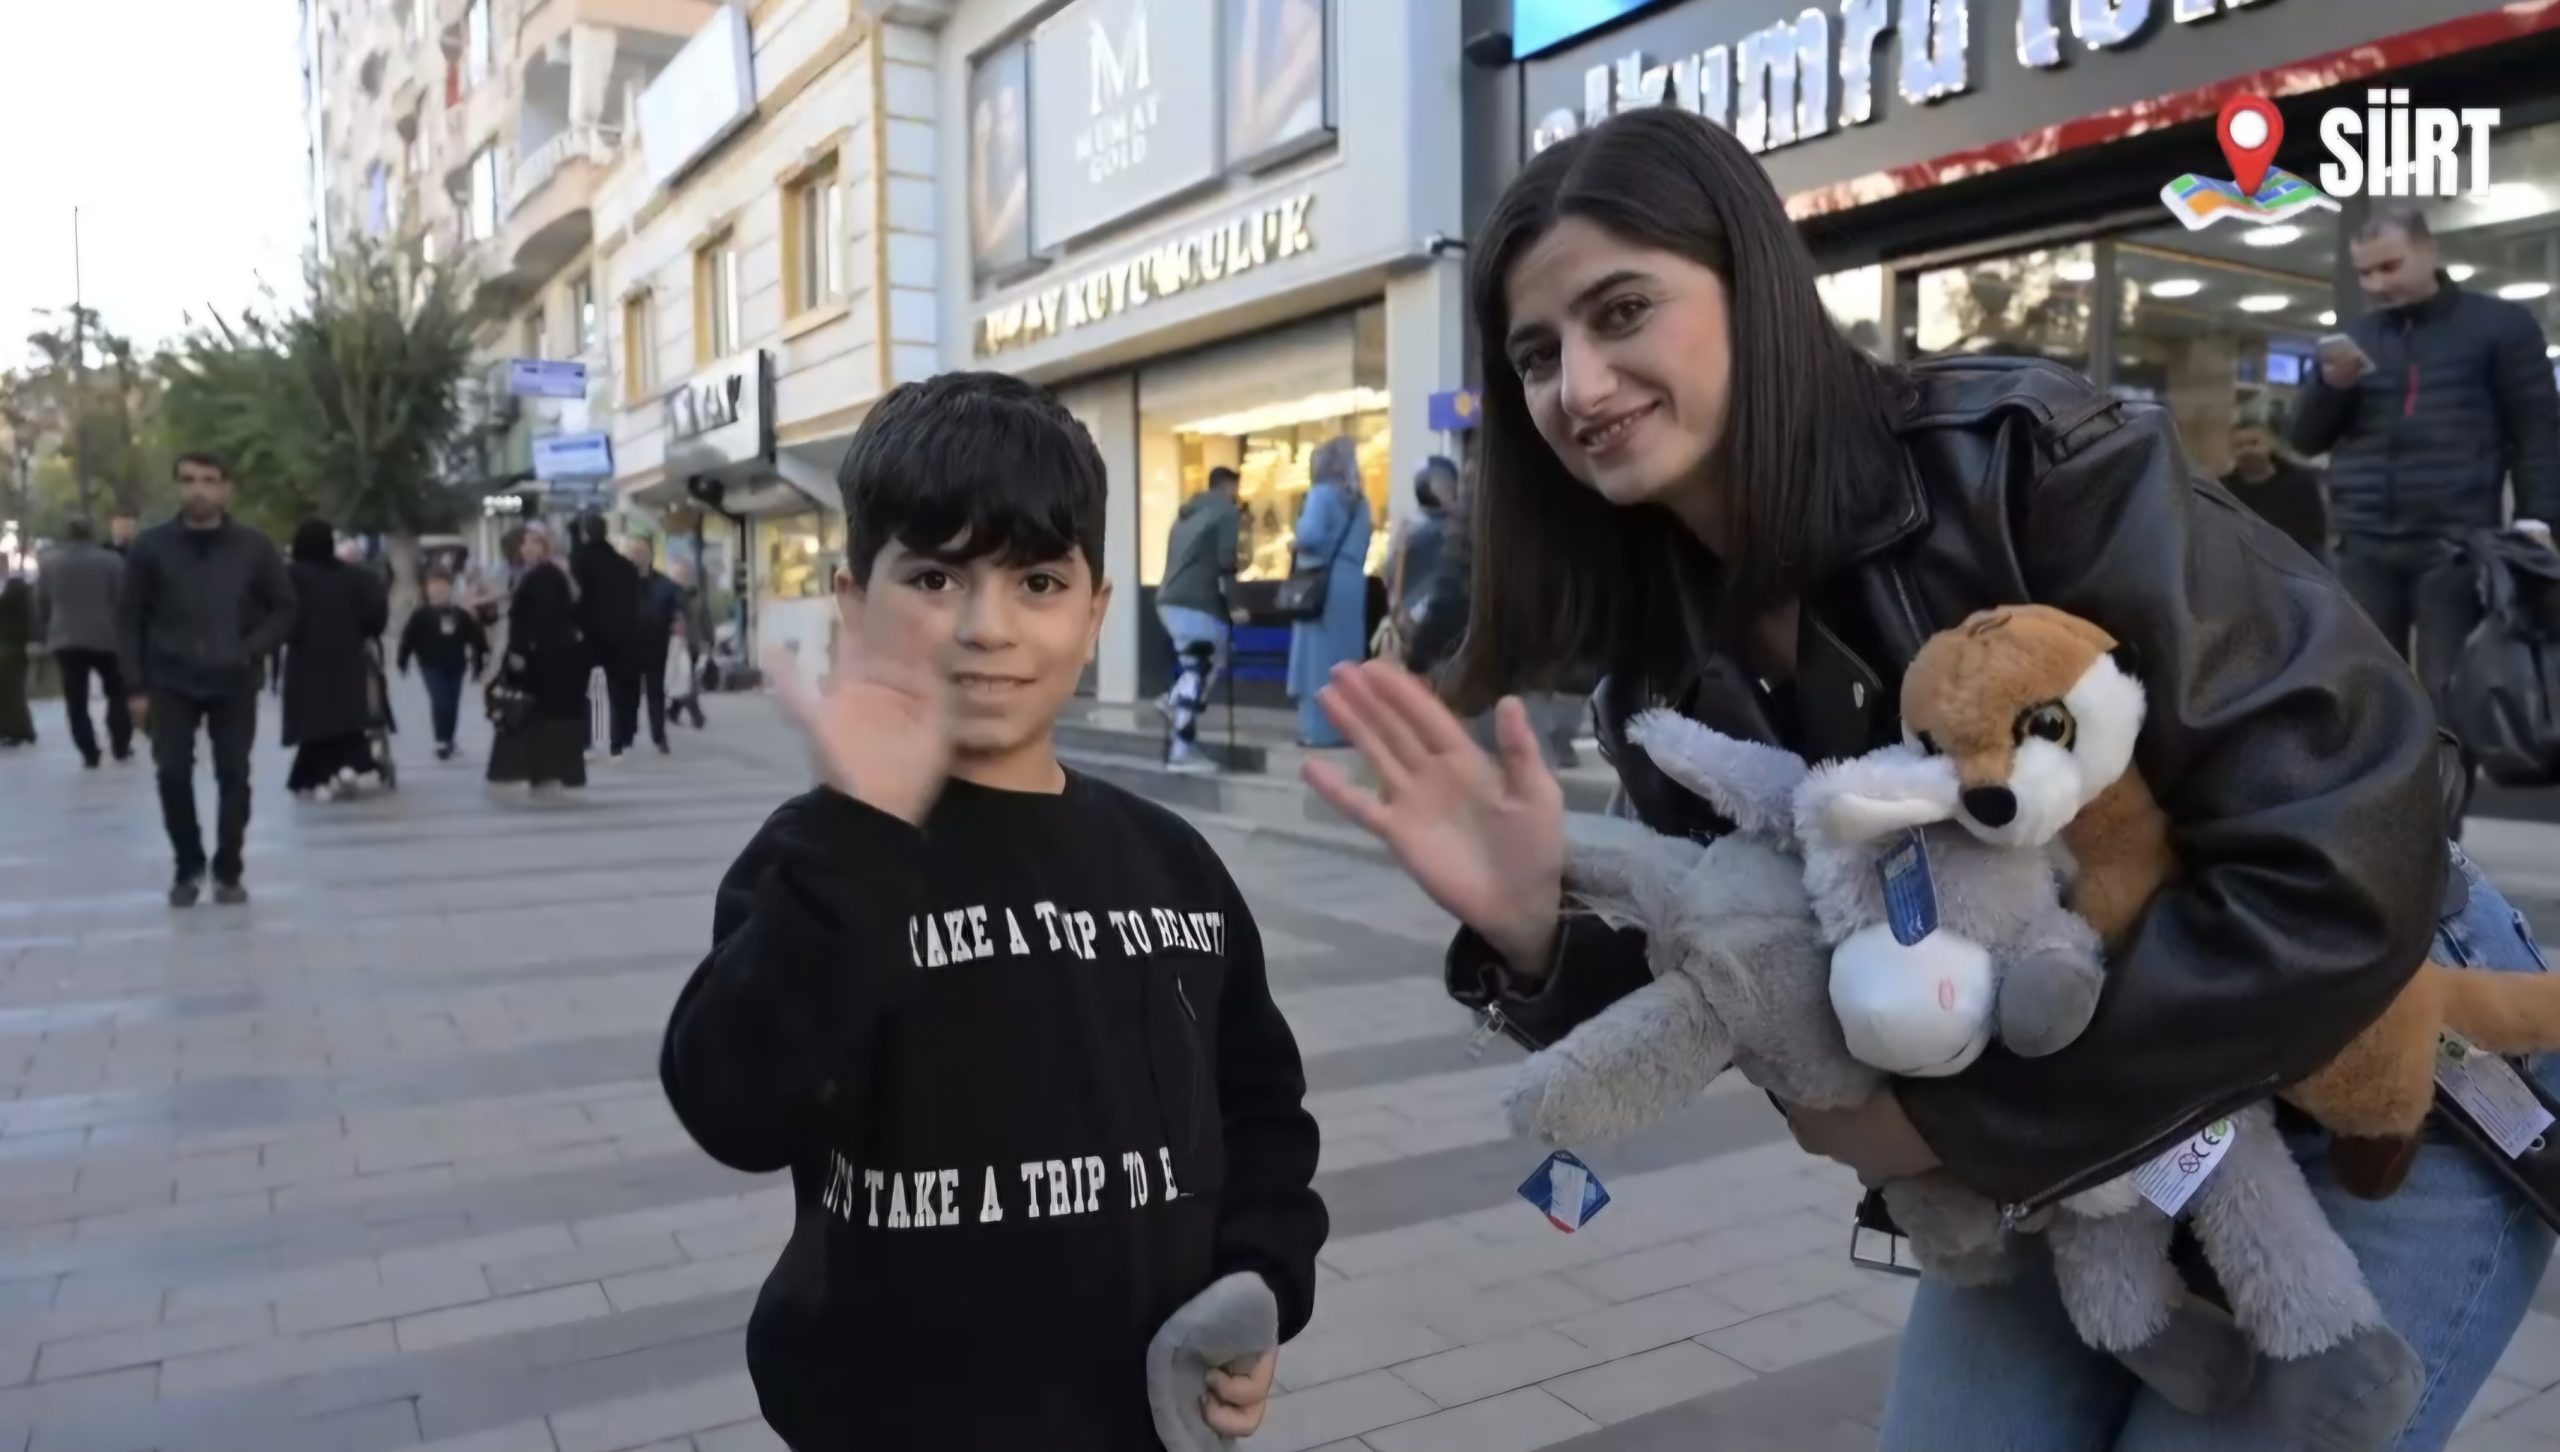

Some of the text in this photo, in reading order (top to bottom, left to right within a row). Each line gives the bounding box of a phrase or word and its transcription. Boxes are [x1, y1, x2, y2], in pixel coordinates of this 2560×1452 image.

[1006, 907, 1031, 955] A
[1108, 910, 1152, 956] TO
[865, 1168, 960, 1228] TAKE
[979, 1165, 1004, 1223] A
[1020, 1155, 1106, 1217] TRIP
[1122, 1150, 1149, 1209] TO
